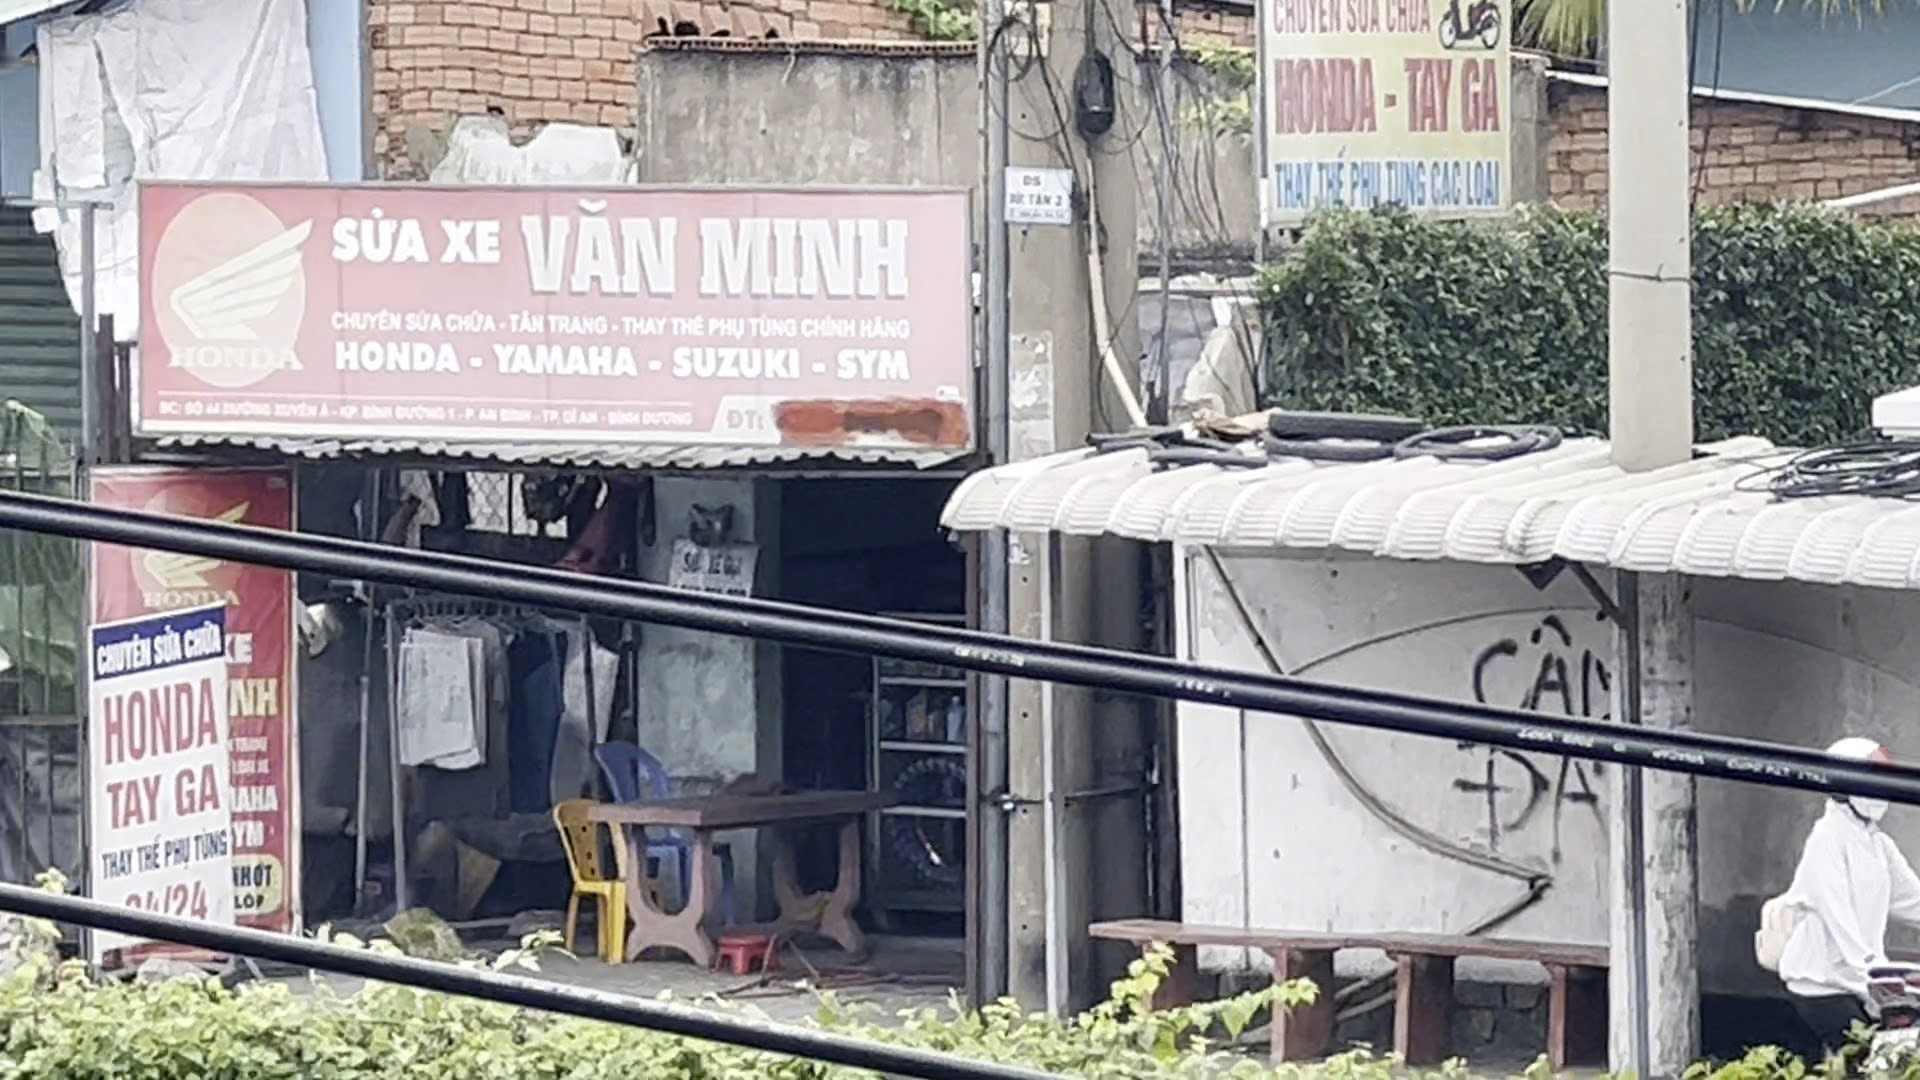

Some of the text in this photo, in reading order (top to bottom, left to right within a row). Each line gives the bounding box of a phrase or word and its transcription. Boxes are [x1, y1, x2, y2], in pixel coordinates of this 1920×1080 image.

[1274, 58, 1377, 134] HONDA
[1404, 58, 1452, 132] TAY
[1461, 58, 1499, 132] GA
[1275, 162, 1312, 208] THAY
[332, 199, 909, 297] SỬA XE VĂN MINH
[548, 315, 608, 334] TRANG
[622, 316, 666, 336] THAY
[708, 316, 745, 340] PHỤ
[168, 346, 304, 370] HONDA
[335, 341, 460, 373] HONDA
[492, 343, 637, 377] YAMAHA
[672, 346, 799, 378] SUZUKI
[837, 348, 910, 380] SYM
[104, 677, 218, 765] HONDA
[106, 764, 220, 829] TAY GA
[102, 848, 132, 879] THAY
